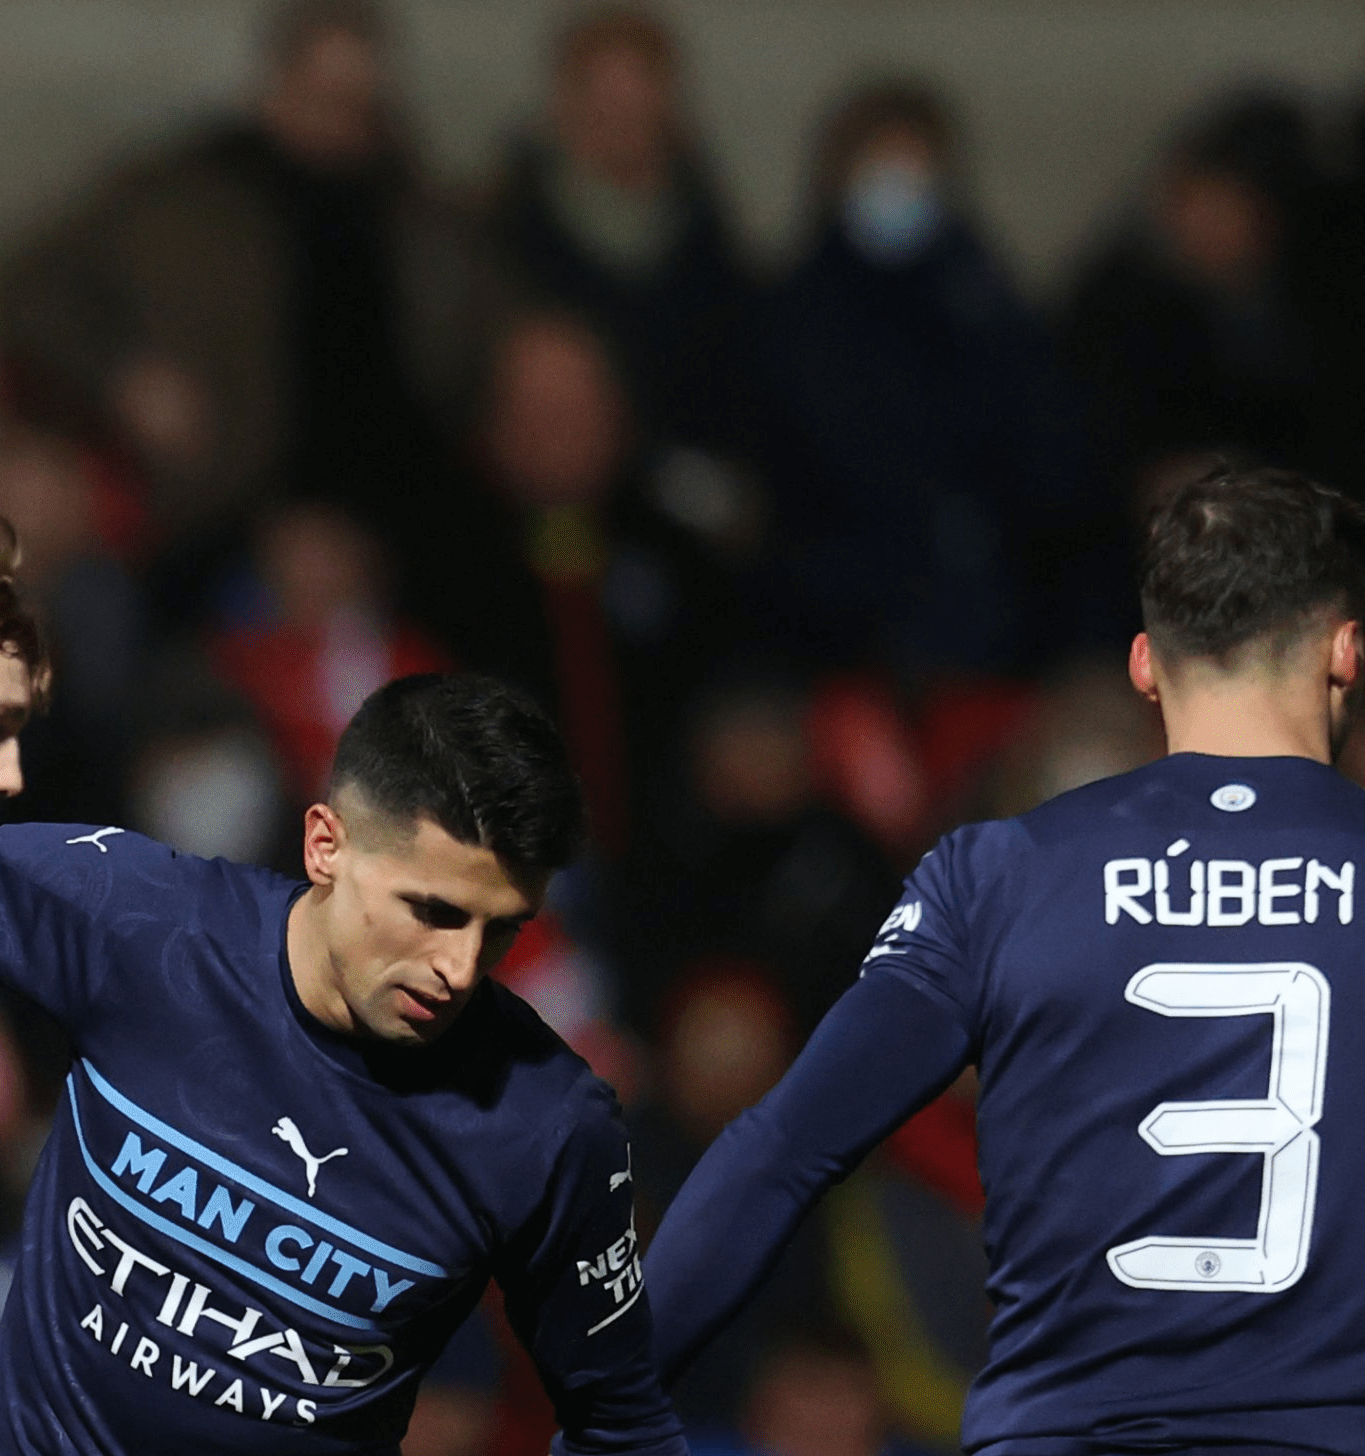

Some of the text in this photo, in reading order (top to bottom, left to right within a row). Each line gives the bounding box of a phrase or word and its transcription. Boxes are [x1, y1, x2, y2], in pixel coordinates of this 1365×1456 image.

[1104, 837, 1355, 927] RÚBEN
[1105, 962, 1331, 1293] 3
[67, 1196, 375, 1388] ETIHAD
[110, 1131, 416, 1314] MAN CITY
[80, 1304, 319, 1426] AIRWAYS
